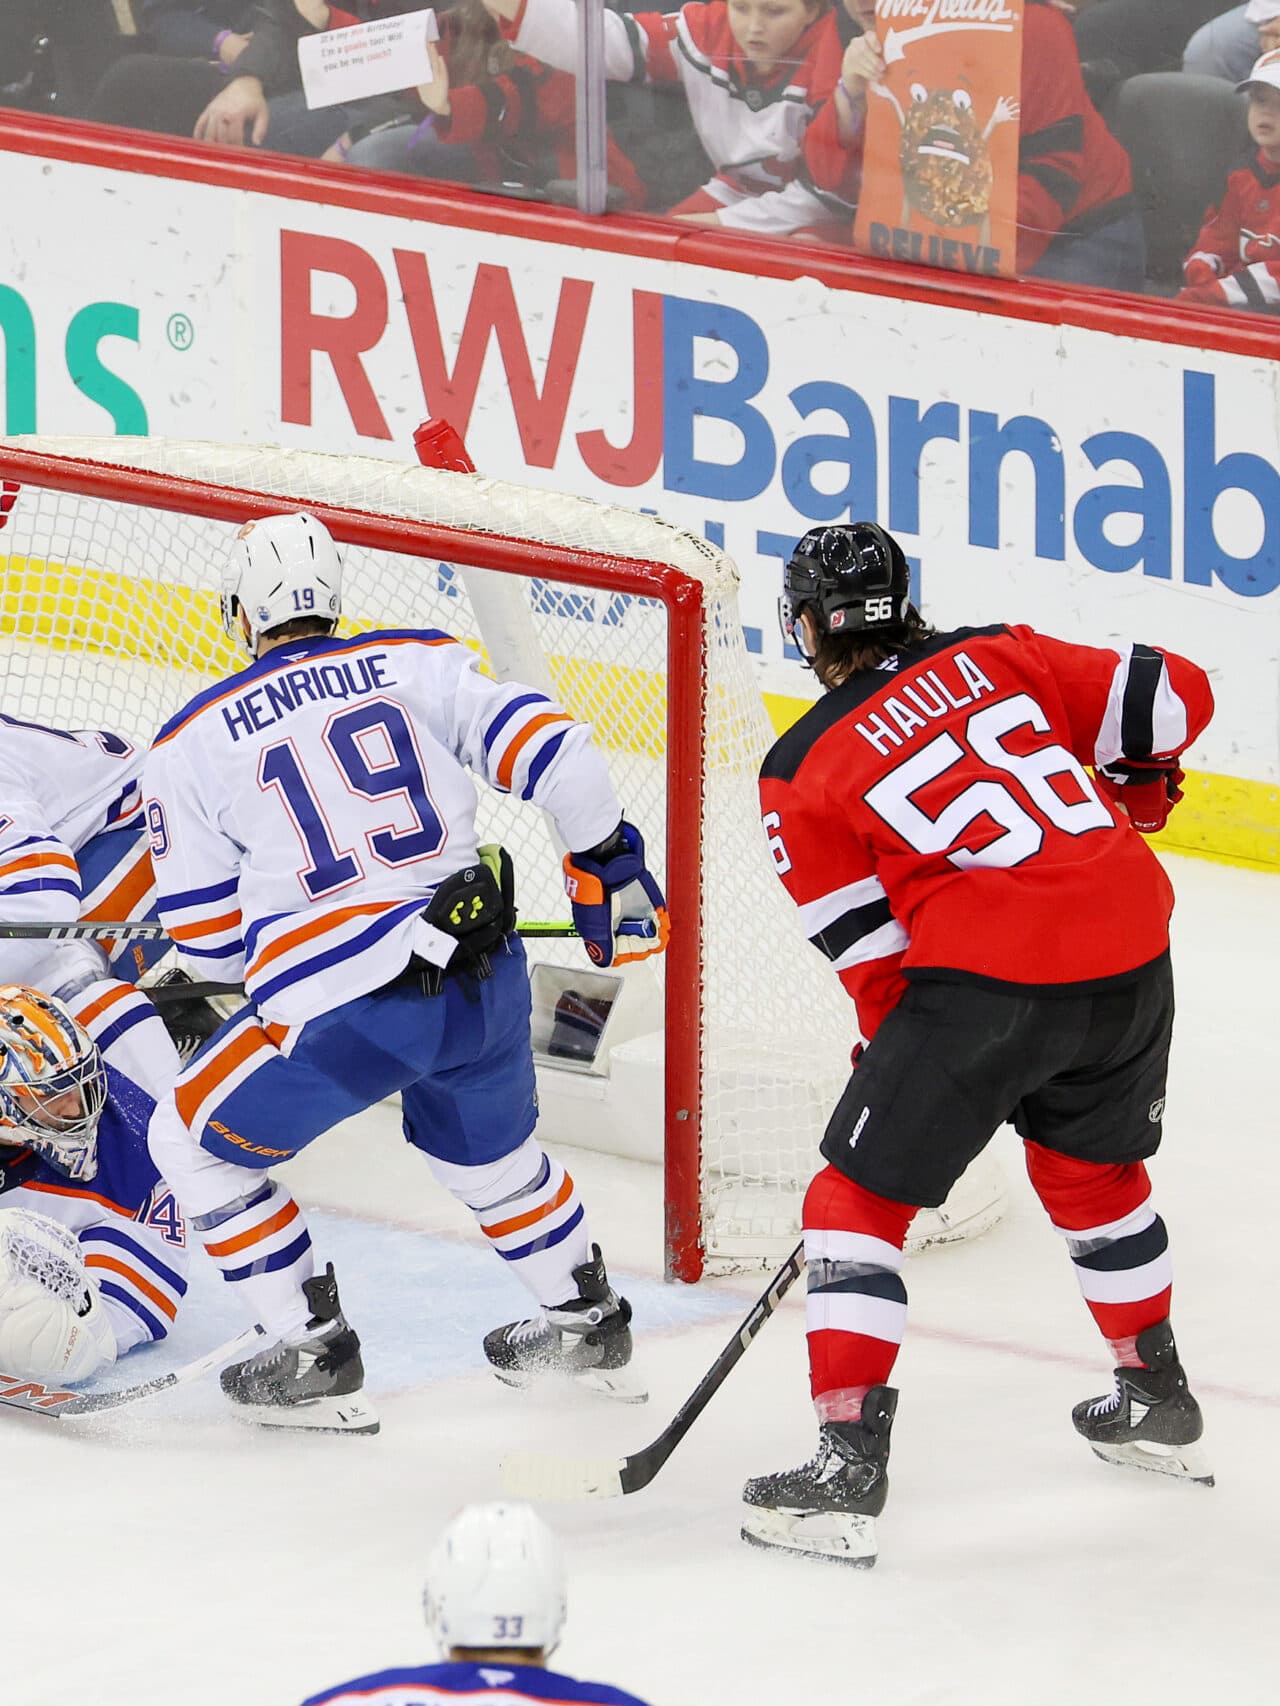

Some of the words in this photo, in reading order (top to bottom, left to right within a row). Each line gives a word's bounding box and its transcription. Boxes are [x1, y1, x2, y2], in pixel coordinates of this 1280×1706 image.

[292, 587, 316, 612] 19
[864, 596, 894, 622] 56
[222, 653, 398, 742] HENRIQUE
[853, 650, 996, 758] HAULA
[256, 695, 449, 902] 19
[862, 691, 1117, 872] 56
[848, 1105, 870, 1149] CCM
[492, 1615, 524, 1640] 33
